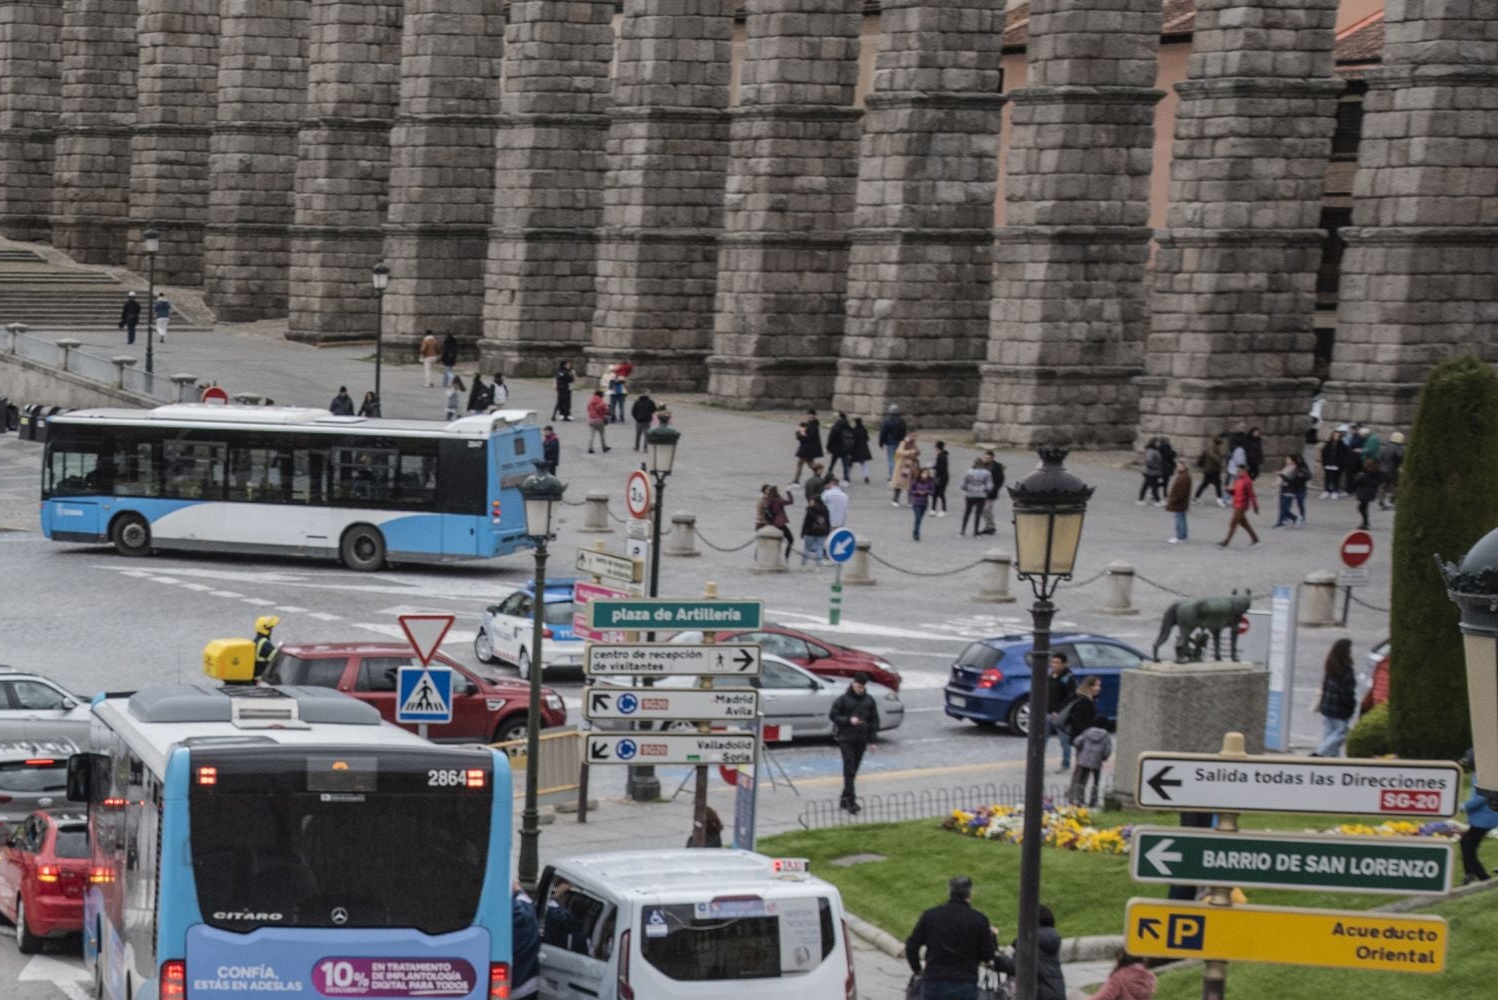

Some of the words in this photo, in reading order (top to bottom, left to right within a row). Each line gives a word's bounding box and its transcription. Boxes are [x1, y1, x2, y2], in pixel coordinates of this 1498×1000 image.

[612, 607, 651, 623] plaza
[654, 607, 673, 621] de
[675, 607, 742, 621] Artillería
[593, 651, 630, 659] centro
[632, 650, 645, 659] de
[648, 650, 702, 662] recepción
[593, 662, 606, 671] de
[610, 662, 664, 671] visitantes
[715, 694, 754, 704] Madrid
[697, 740, 752, 750] Valladolid
[722, 752, 751, 762] Soria
[428, 769, 468, 786] 2864
[1195, 768, 1248, 783] Salida
[1254, 770, 1303, 785] todas
[1309, 772, 1335, 786] las
[1341, 772, 1447, 790] Direcciones
[1383, 792, 1439, 809] SG-20
[1203, 850, 1271, 870] BARRIO
[1275, 854, 1301, 872] DE
[1305, 855, 1346, 875] SAN
[1350, 857, 1439, 879] LORENZO
[213, 911, 283, 921] CITARO
[1331, 921, 1438, 942] Acueducto
[1355, 945, 1435, 965] Oriental
[371, 962, 385, 972] EN
[387, 962, 452, 972] TRATAMIENTO
[321, 961, 369, 988] 10%
[371, 972, 384, 981] DE
[194, 979, 230, 991] ESTÁS
[232, 980, 247, 991] EN
[250, 980, 303, 992] ADESLAS
[371, 981, 408, 990] DIGITAL
[409, 981, 434, 990] PARA
[436, 981, 469, 990] TODOS
